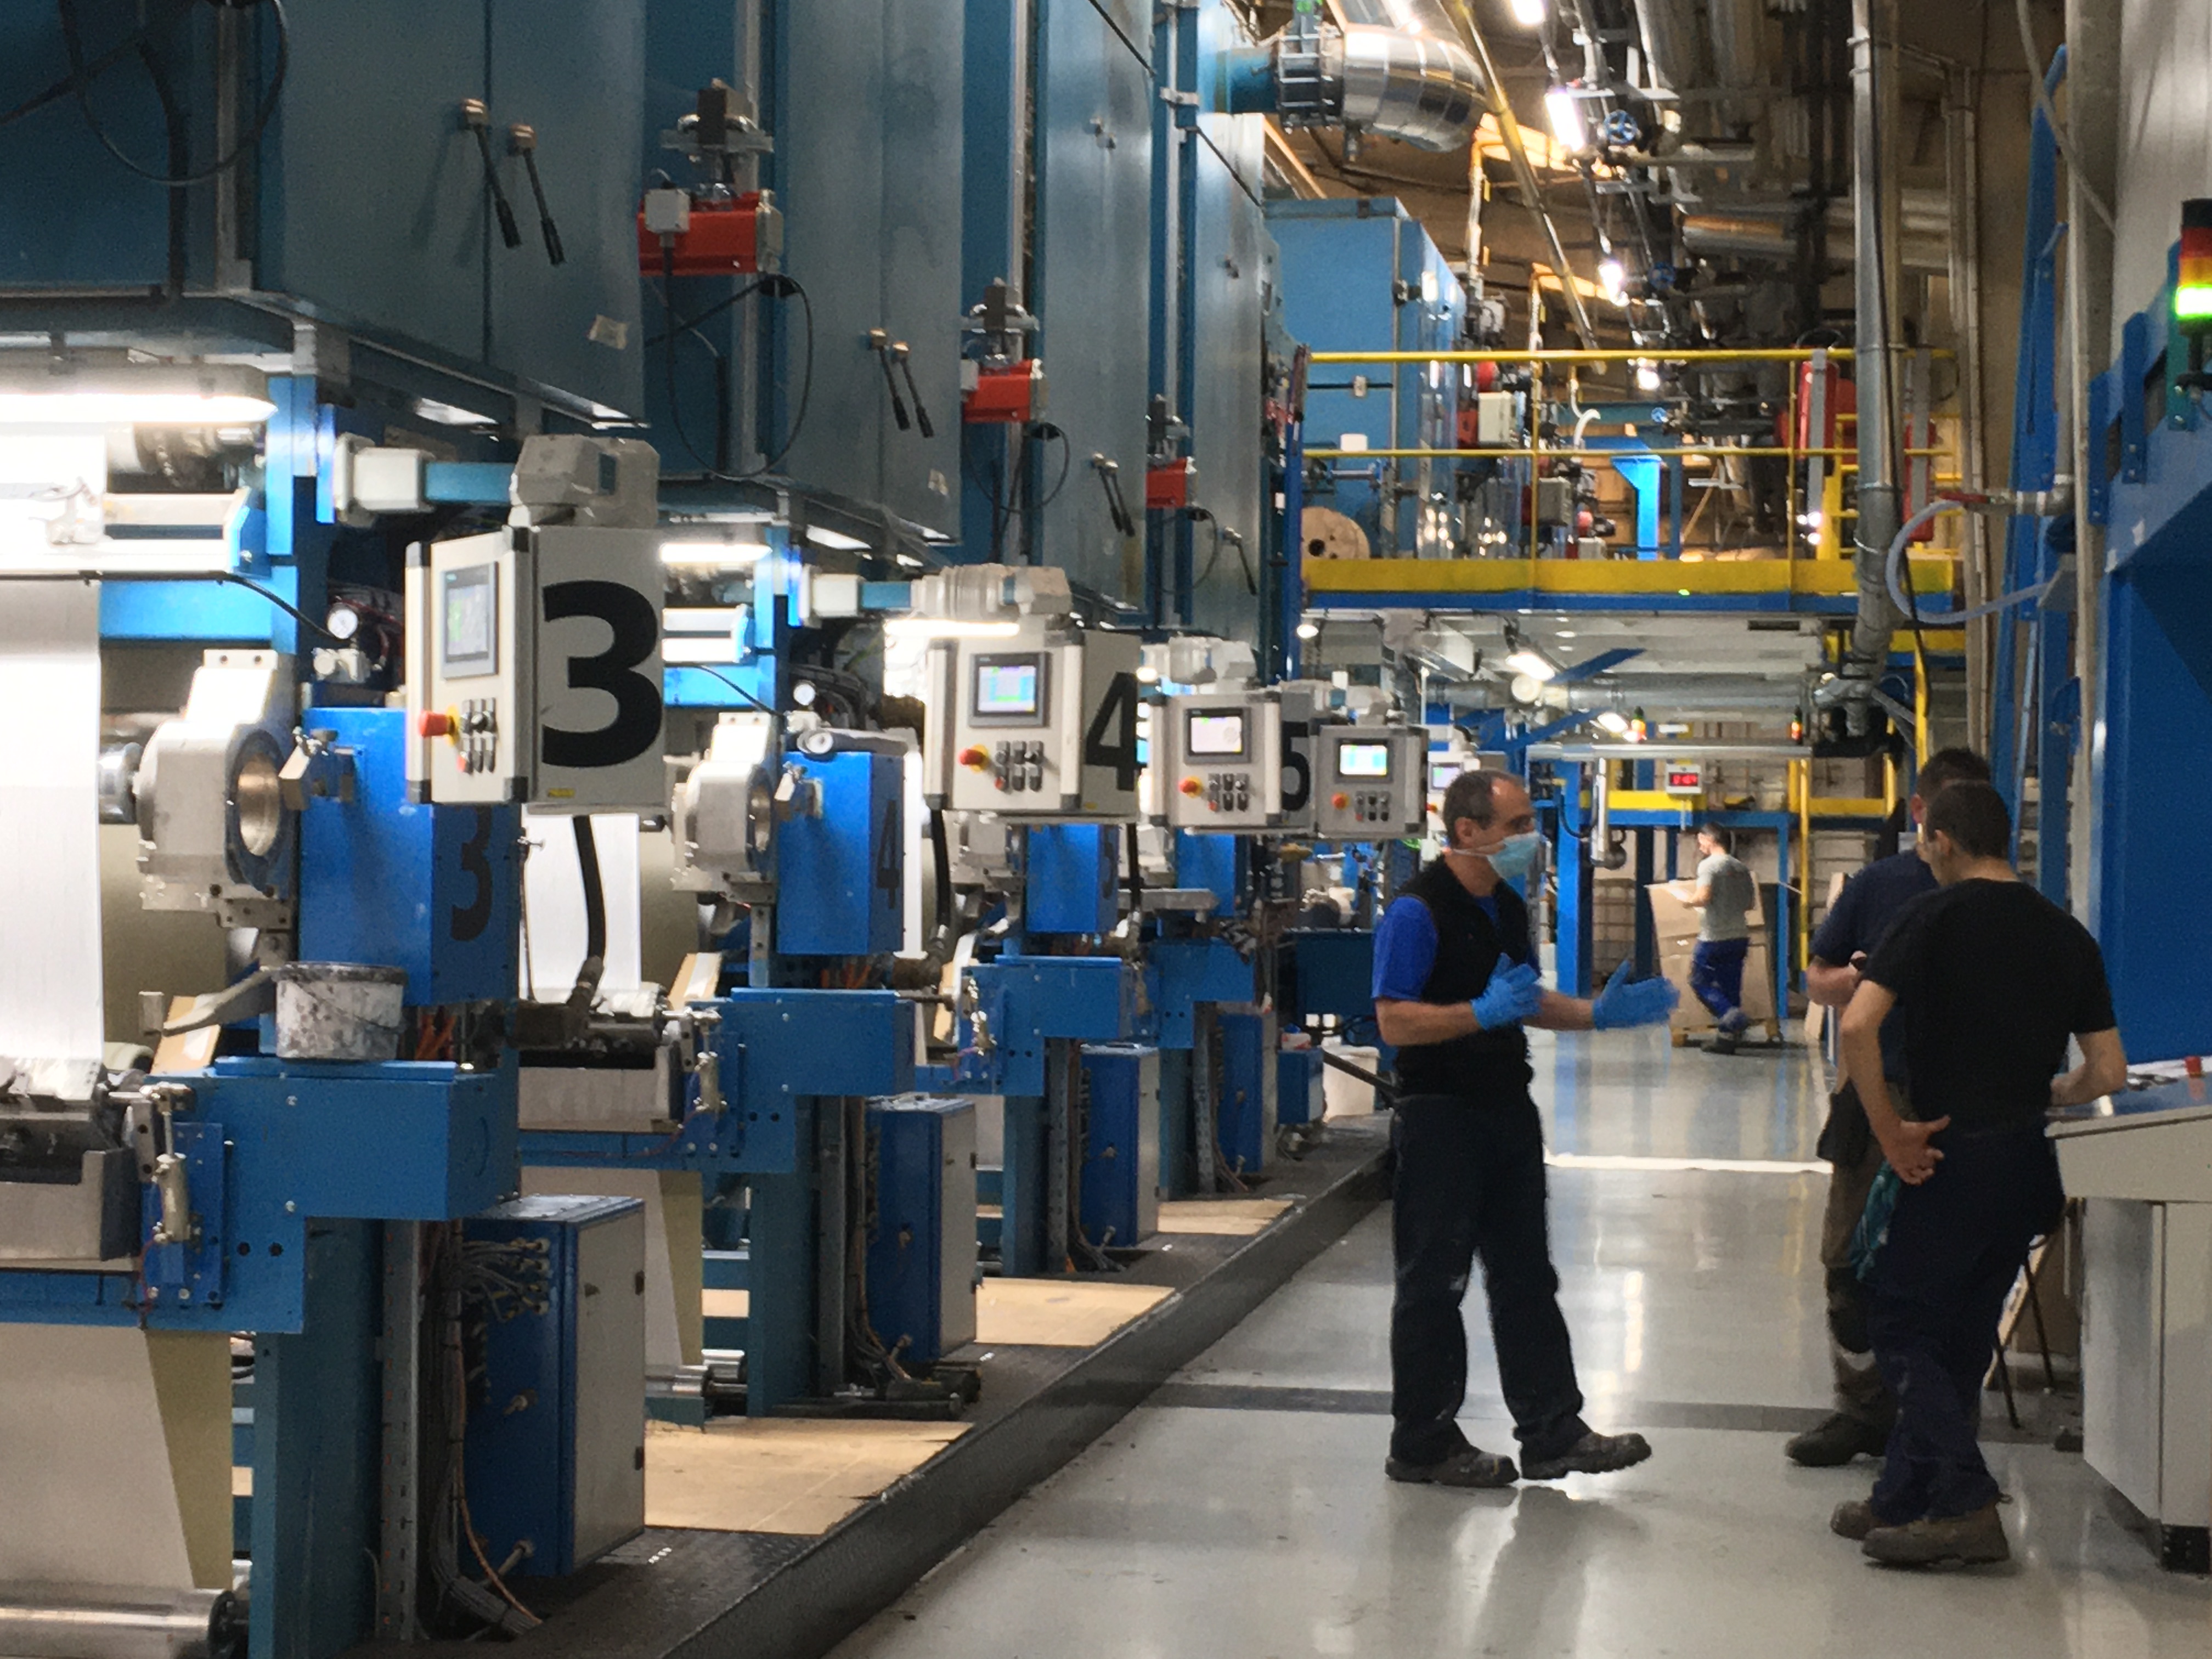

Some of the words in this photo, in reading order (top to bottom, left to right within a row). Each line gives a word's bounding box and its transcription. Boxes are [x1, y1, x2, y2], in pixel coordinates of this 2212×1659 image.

[541, 580, 662, 768] 3
[1085, 672, 1137, 792] 4
[1282, 721, 1310, 812] 5
[450, 805, 492, 942] 3
[877, 800, 900, 909] 4
